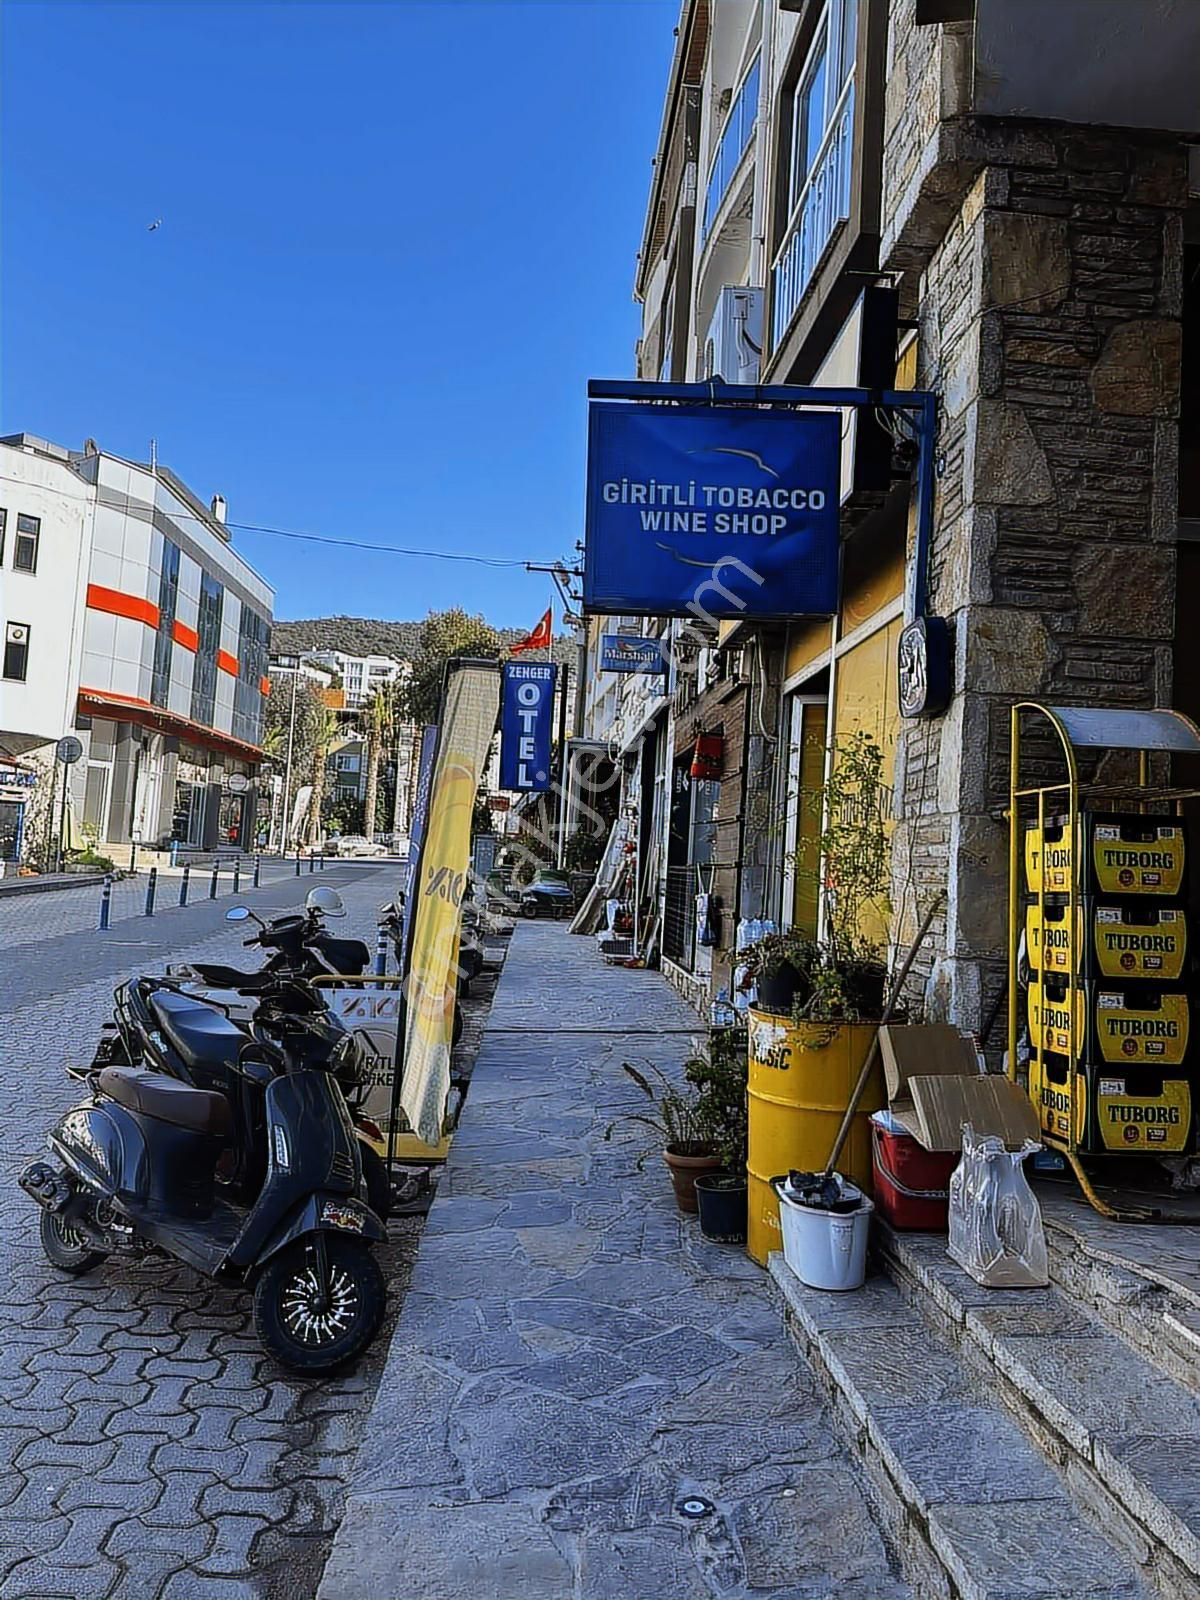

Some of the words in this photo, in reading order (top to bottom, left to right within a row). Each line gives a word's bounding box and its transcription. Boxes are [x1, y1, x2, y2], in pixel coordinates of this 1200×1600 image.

[603, 478, 696, 506] GİRİTLİ
[702, 486, 825, 510] TOBACCO
[640, 511, 707, 533] WINE
[714, 513, 787, 535] SHOP
[517, 682, 541, 788] OTEL
[1104, 850, 1175, 870] TUBORG
[1105, 933, 1176, 953] TUBORG
[1107, 1018, 1179, 1038] TUBORG
[1108, 1105, 1180, 1125] TUBORG
